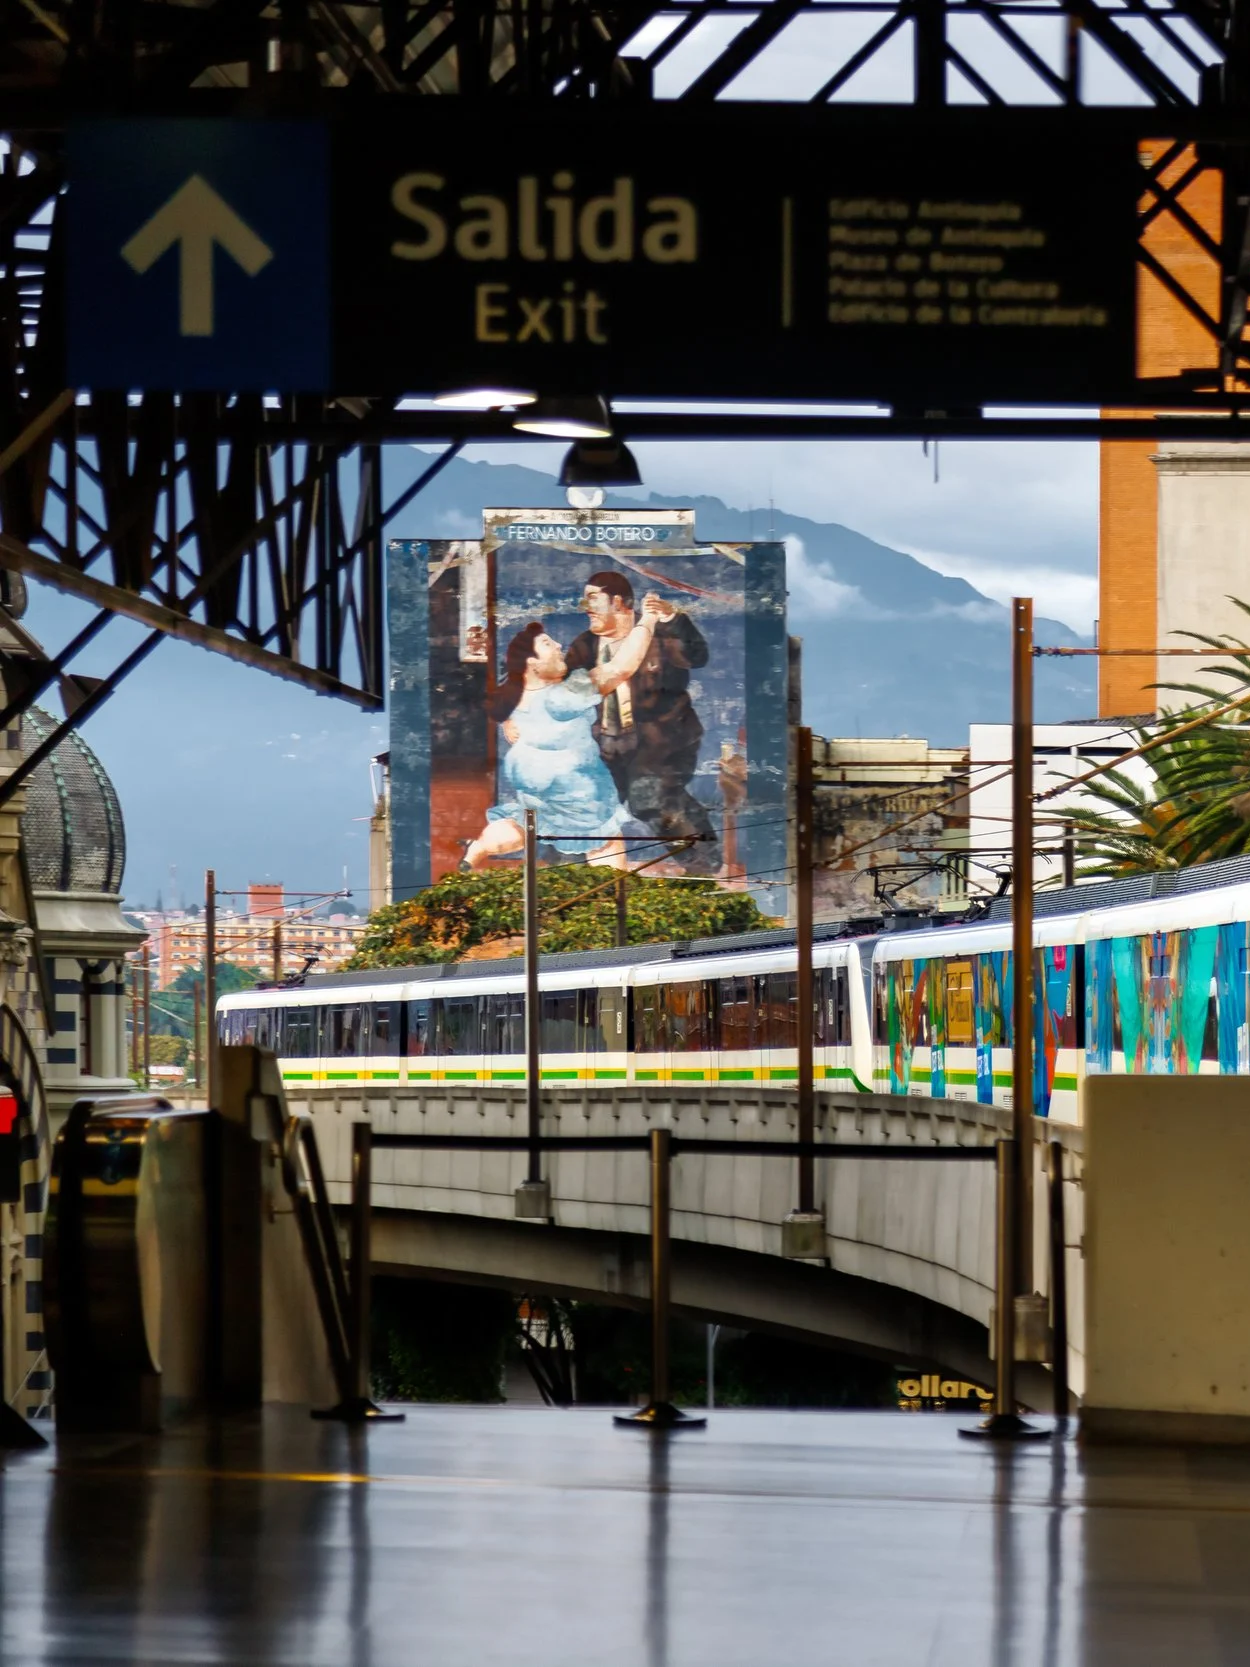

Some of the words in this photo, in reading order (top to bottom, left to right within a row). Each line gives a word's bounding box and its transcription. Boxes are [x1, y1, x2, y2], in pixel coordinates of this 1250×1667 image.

[391, 172, 699, 262] Salida
[904, 227, 932, 246] de
[895, 252, 921, 272] de
[913, 278, 940, 299] de
[947, 279, 969, 299] la
[476, 281, 608, 344] Exit
[915, 304, 943, 325] de
[949, 304, 971, 325] la
[508, 526, 592, 541] FERNANDO
[596, 527, 655, 542] BOTERO
